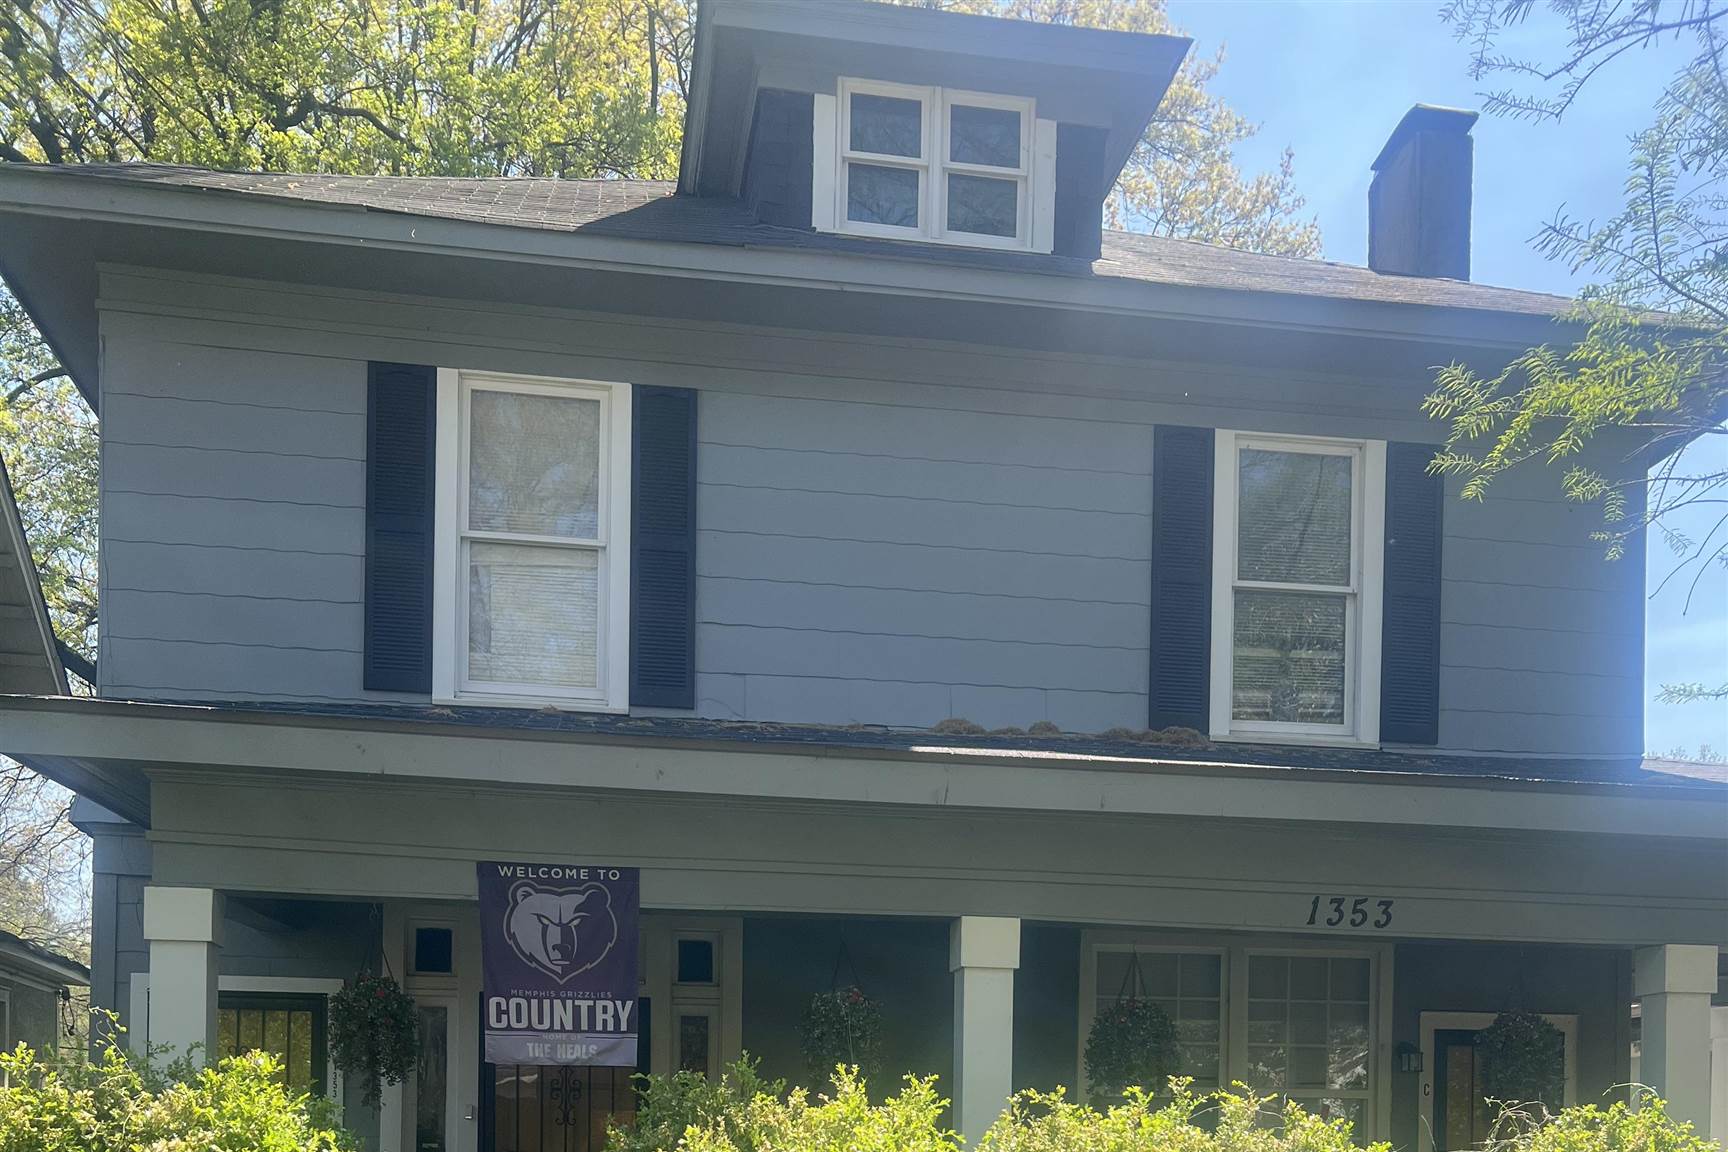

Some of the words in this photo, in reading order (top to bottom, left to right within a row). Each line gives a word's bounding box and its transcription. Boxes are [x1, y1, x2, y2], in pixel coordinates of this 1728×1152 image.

[498, 865, 589, 880] WELCOME
[597, 869, 620, 881] TO
[1306, 895, 1394, 929] 1353
[510, 989, 556, 998] MEMPHIS
[560, 990, 613, 999] GRIZZLIES
[488, 996, 634, 1032] COUNTRY
[526, 1042, 551, 1058] THE
